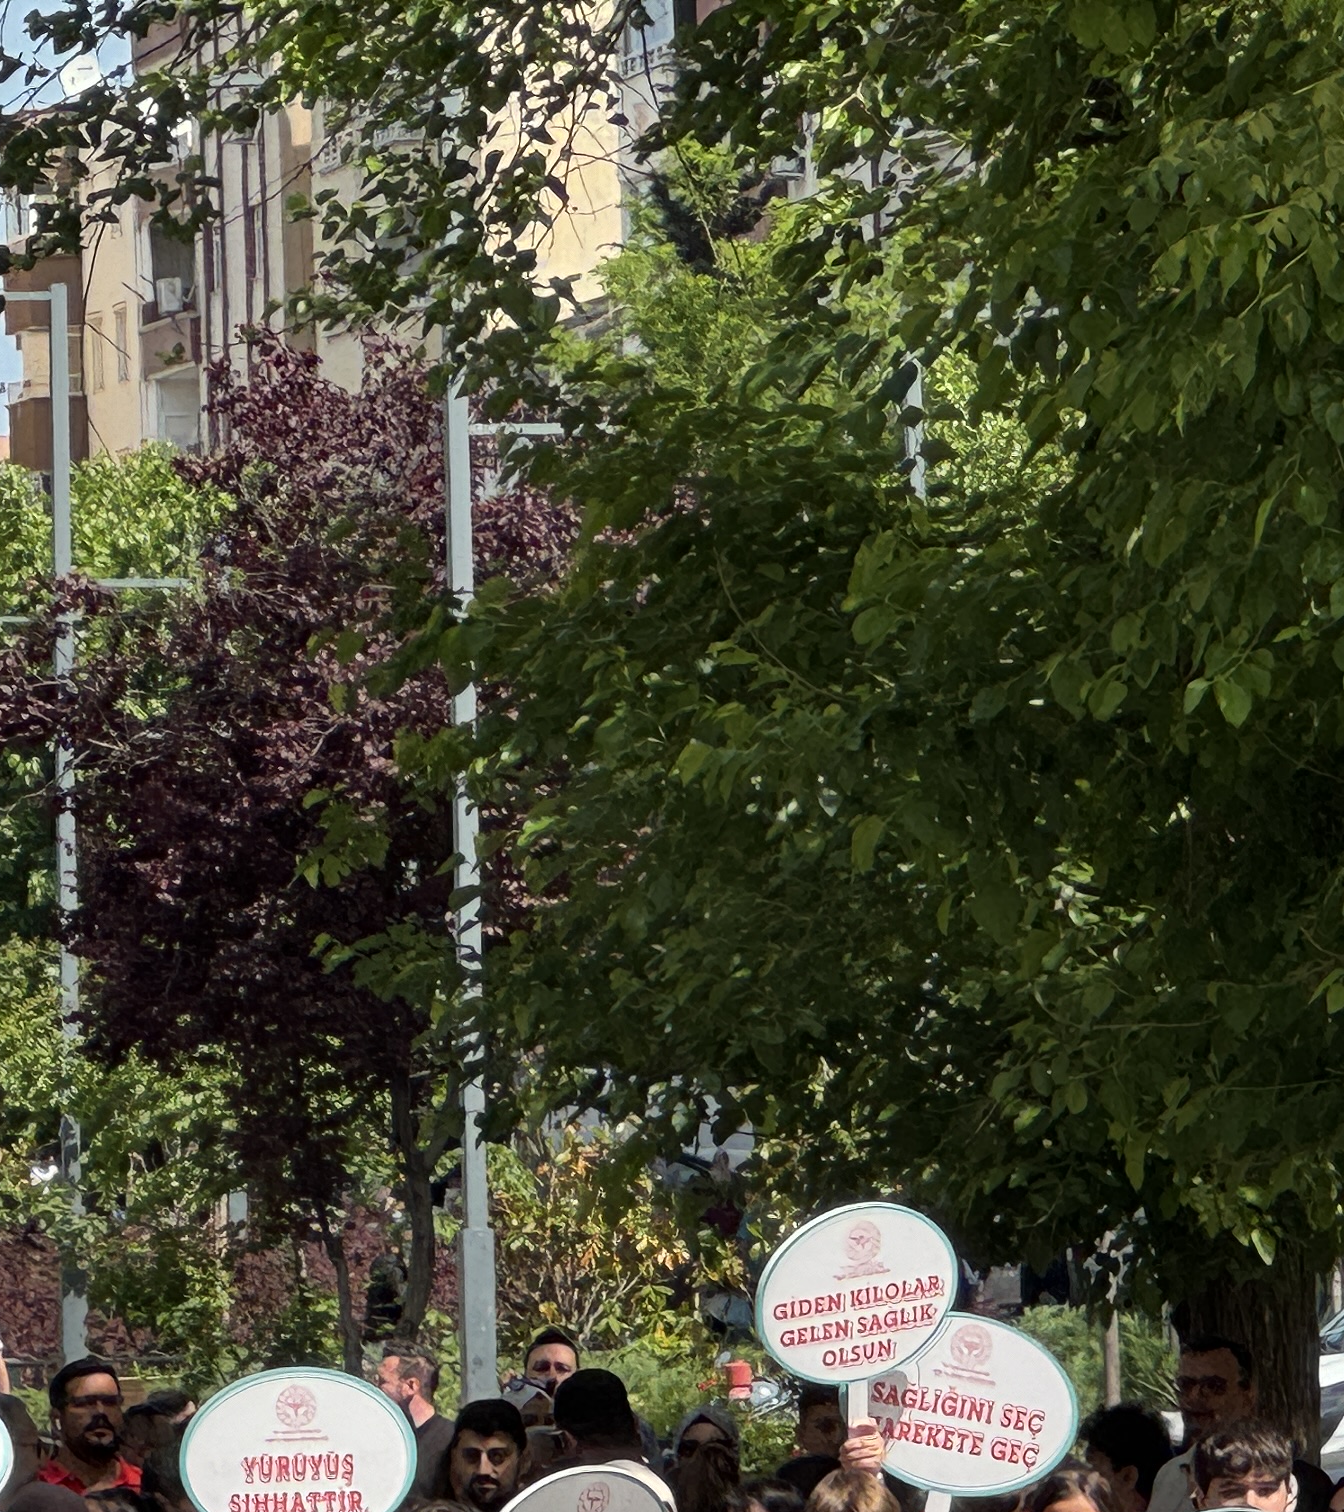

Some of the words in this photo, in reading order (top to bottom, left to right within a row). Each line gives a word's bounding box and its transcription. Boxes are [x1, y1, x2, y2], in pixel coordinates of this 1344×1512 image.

[780, 1319, 853, 1347] GELEN
[822, 1338, 897, 1367] OLSUN
[1000, 1403, 1046, 1440] SEÇ
[868, 1415, 985, 1456] AREKETE
[990, 1437, 1040, 1473] GEÇ
[241, 1451, 354, 1487] YÜRÜYÜŞ
